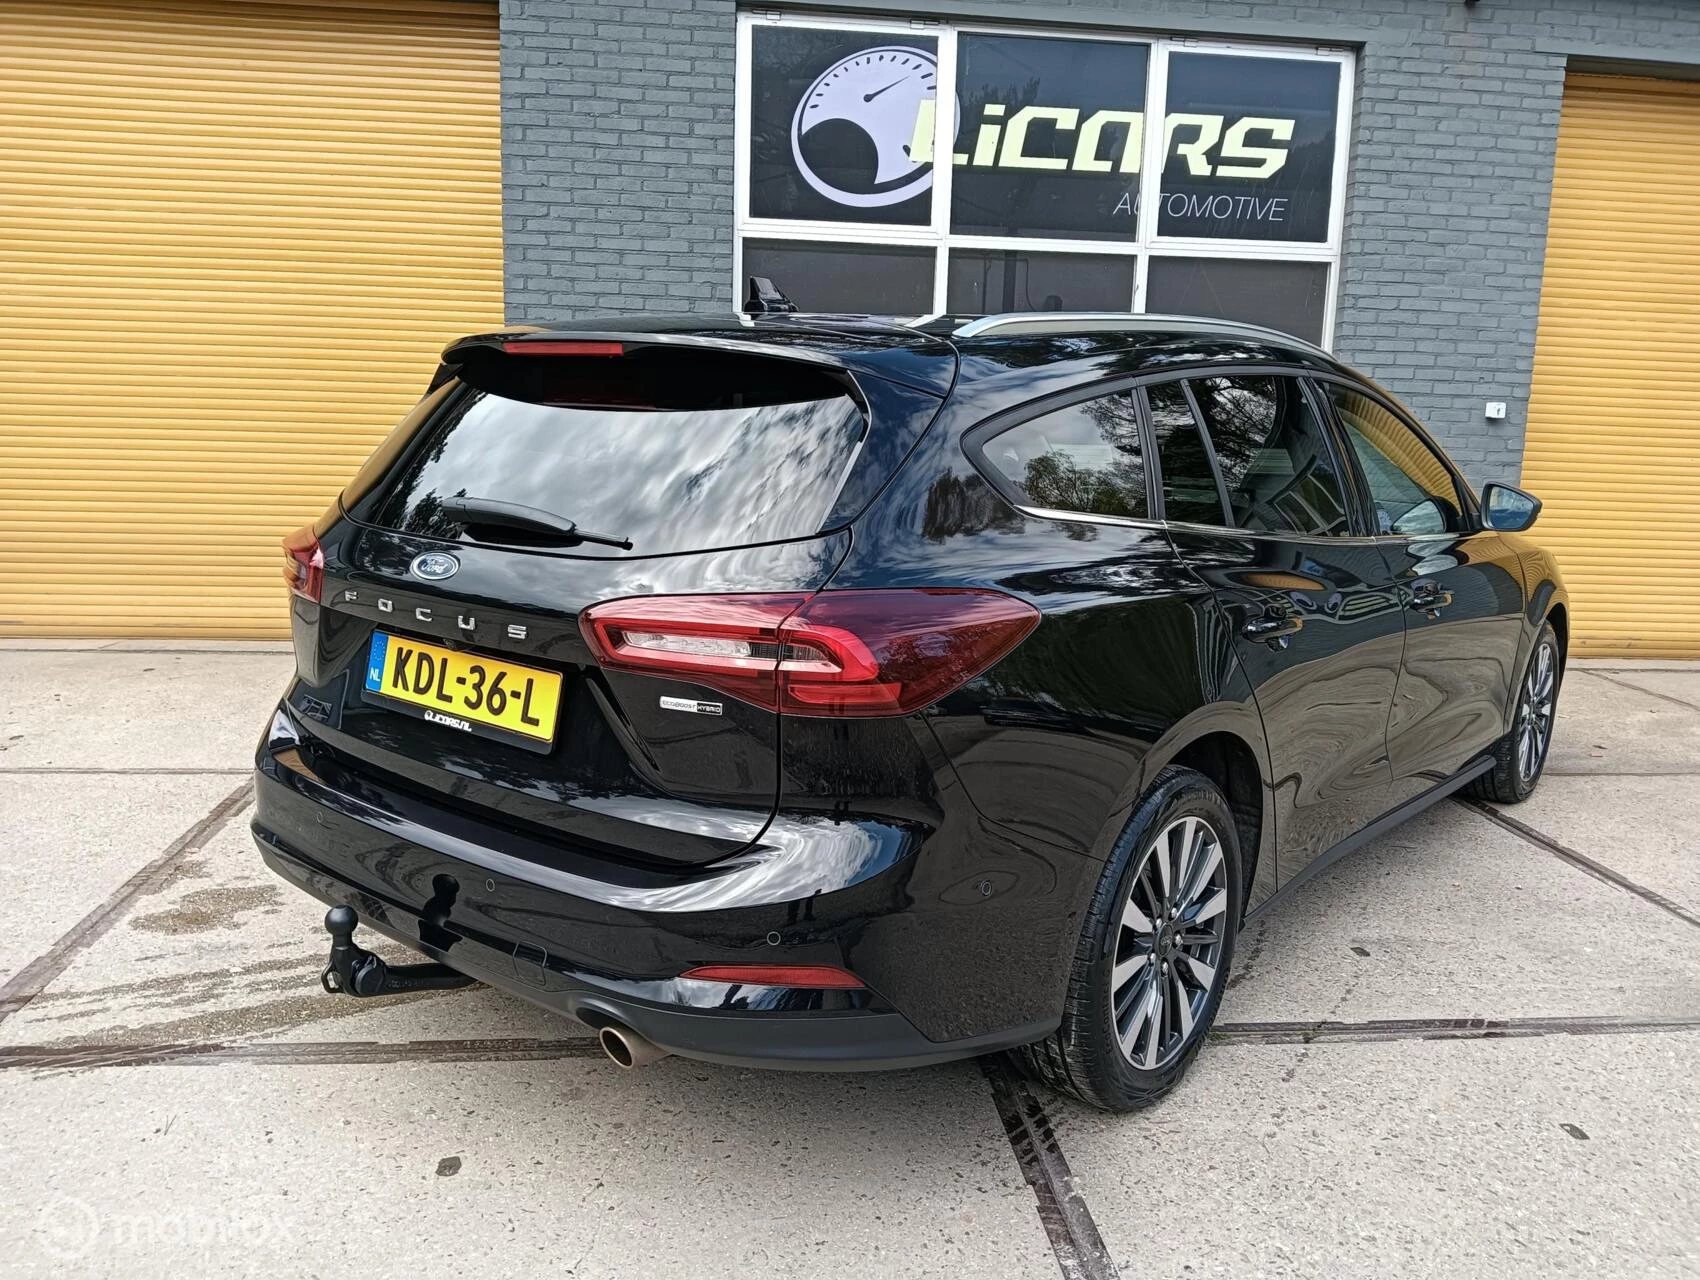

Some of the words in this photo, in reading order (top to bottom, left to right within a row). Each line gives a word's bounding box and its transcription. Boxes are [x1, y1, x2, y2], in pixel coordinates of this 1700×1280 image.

[1112, 192, 1289, 221] ATOMOTIVE
[420, 556, 449, 575] Ford
[344, 590, 528, 640] FOCUS
[369, 668, 381, 682] NL
[392, 646, 540, 727] KDL-36-L
